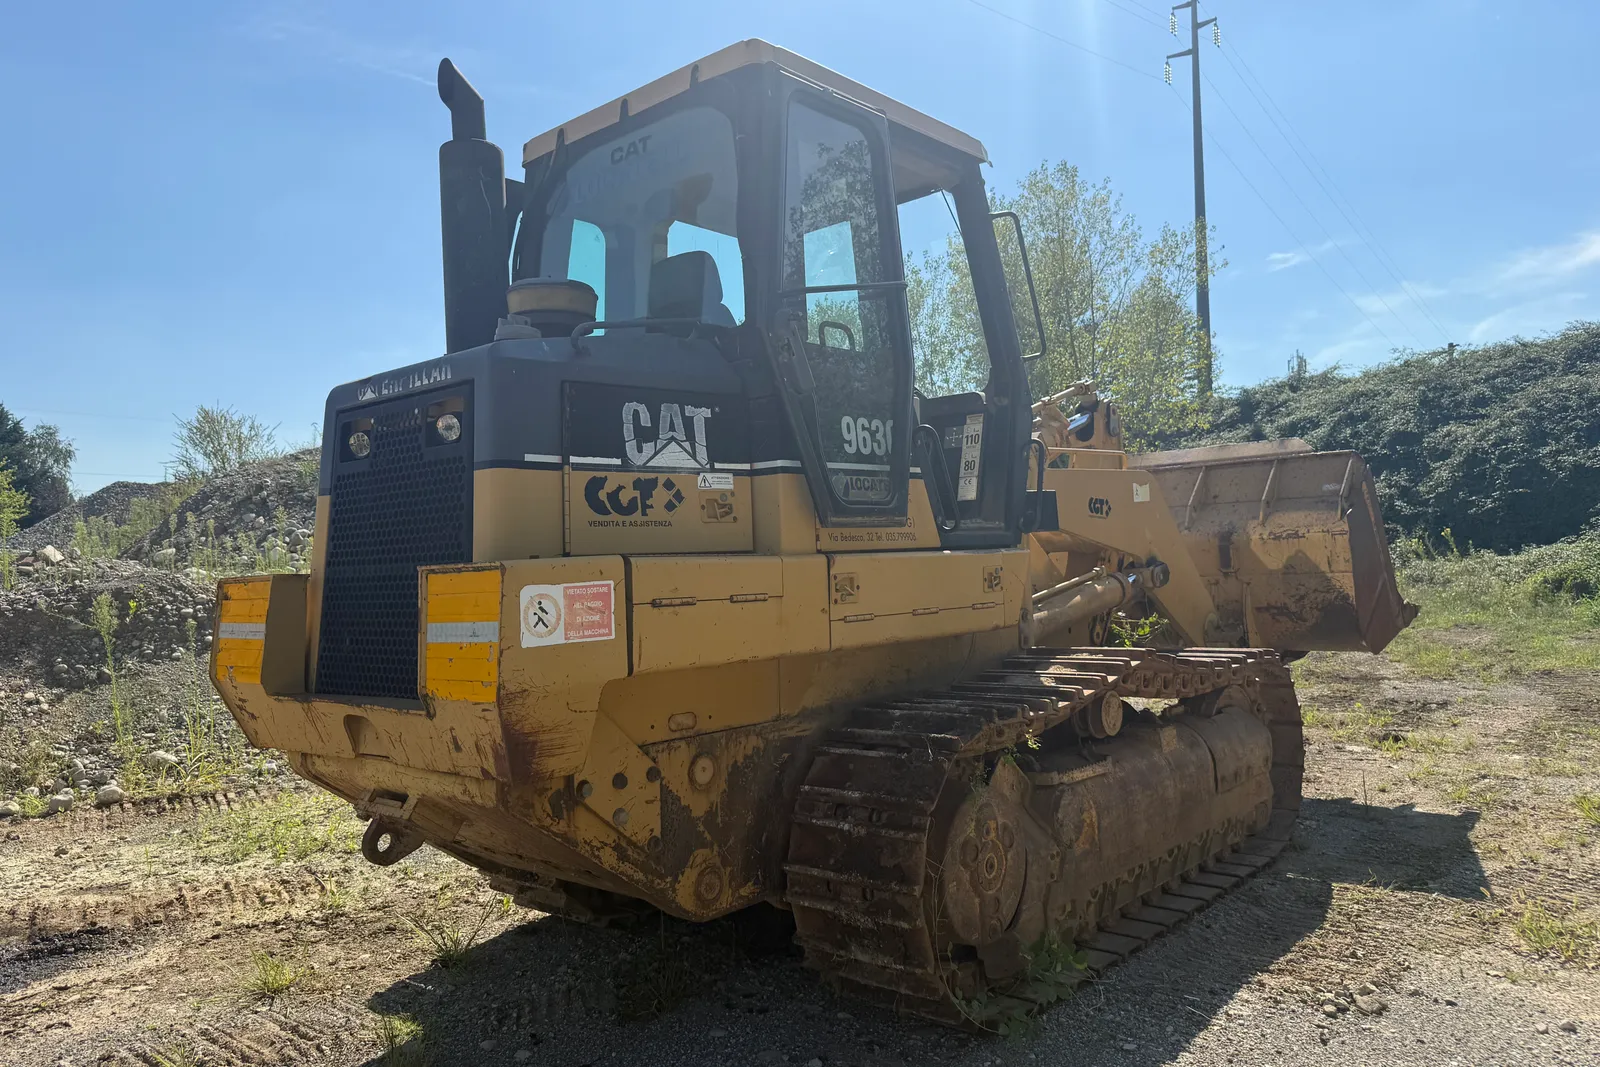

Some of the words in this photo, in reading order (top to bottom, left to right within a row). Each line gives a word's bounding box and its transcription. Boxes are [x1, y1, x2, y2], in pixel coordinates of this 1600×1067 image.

[610, 135, 652, 164] CAT
[622, 401, 712, 468] CAT
[965, 433, 980, 446] 110
[964, 459, 976, 472] 80
[588, 520, 620, 528] VENDITA
[629, 520, 673, 528] ASSISTENZA
[828, 532, 838, 541] Via
[867, 532, 874, 541] 32
[567, 587, 587, 595] VIETATO
[584, 628, 608, 636] MACCHINA
